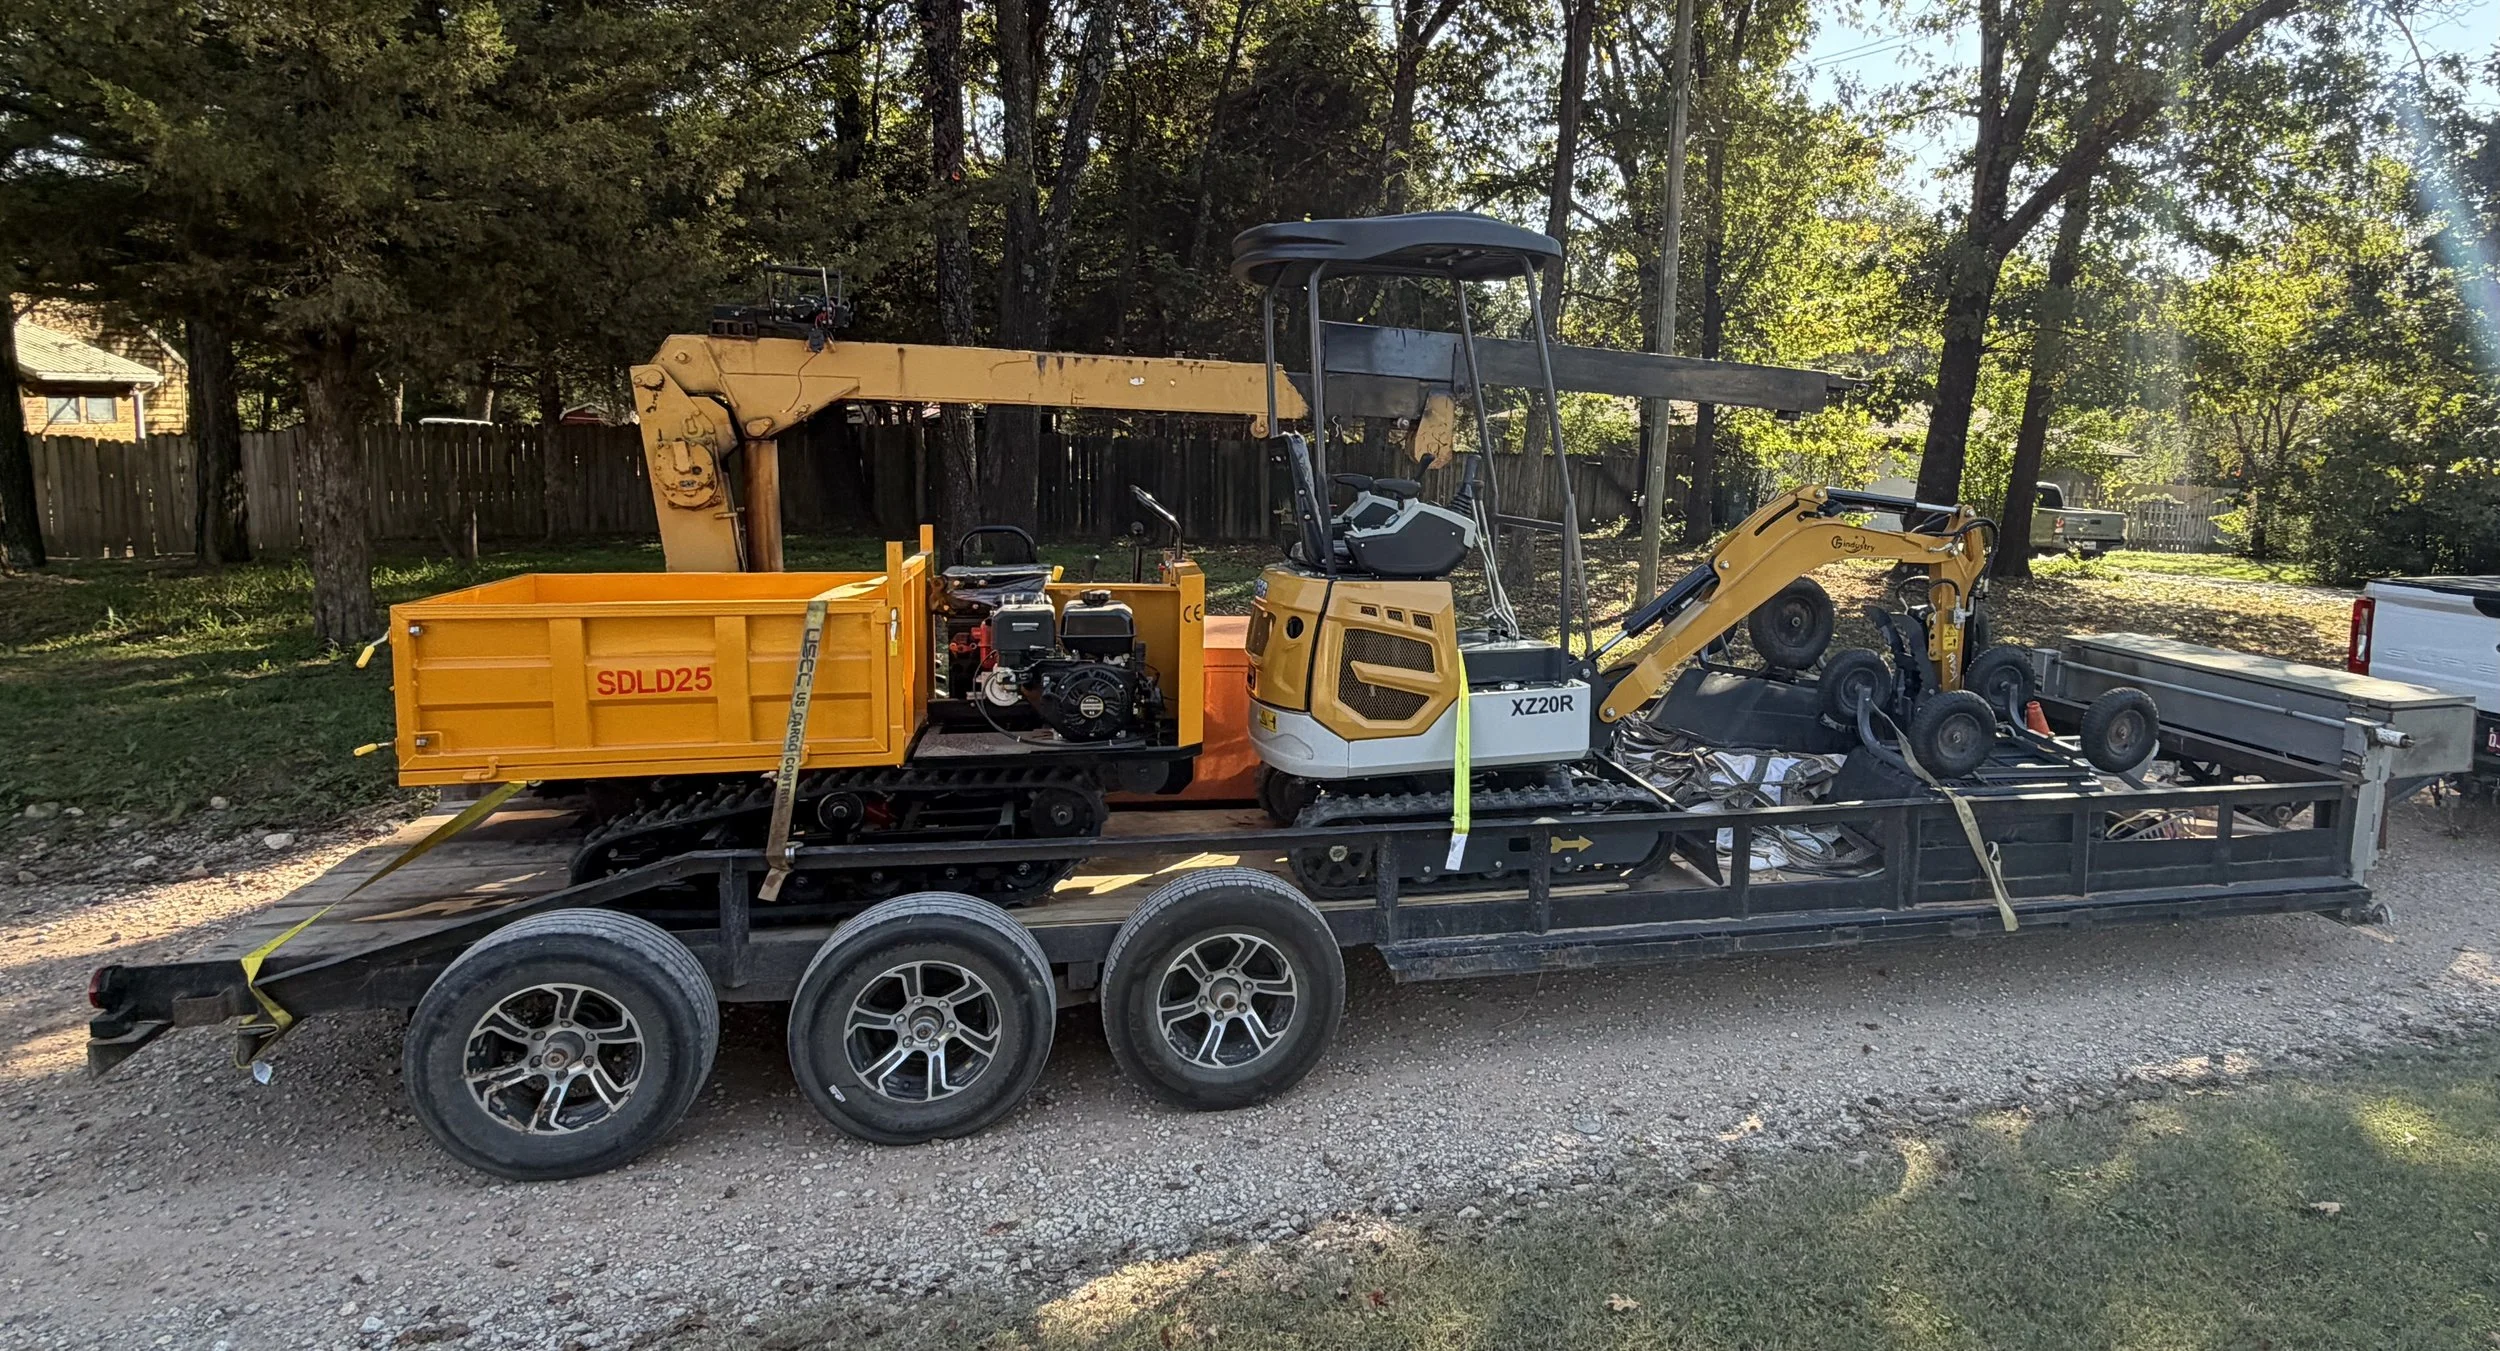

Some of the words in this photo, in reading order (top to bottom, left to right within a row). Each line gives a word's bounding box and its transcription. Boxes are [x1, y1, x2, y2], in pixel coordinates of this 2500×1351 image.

[1183, 603, 1202, 623] CE
[597, 667, 713, 695] SDLD25
[795, 692, 807, 708] US
[1511, 694, 1574, 717] XZ20R
[788, 712, 804, 752] CARGO
